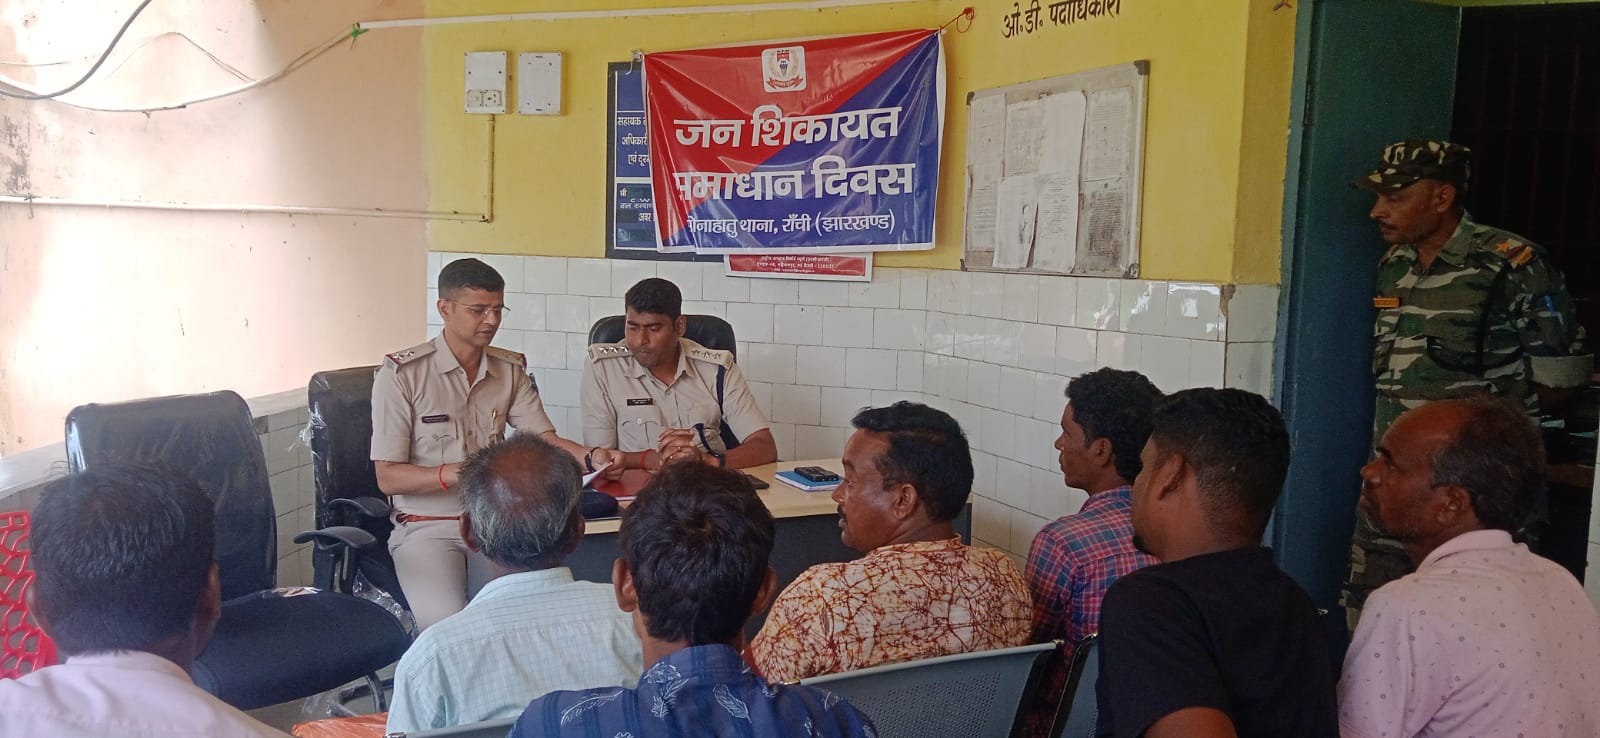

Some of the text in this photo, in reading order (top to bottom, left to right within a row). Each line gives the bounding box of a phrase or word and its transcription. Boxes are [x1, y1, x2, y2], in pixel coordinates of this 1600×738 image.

[673, 104, 902, 148] जन शिकायत
[811, 156, 917, 200] दिवस
[687, 208, 896, 238] ोनाहातु थाना, राँची (झारखण्ड)
